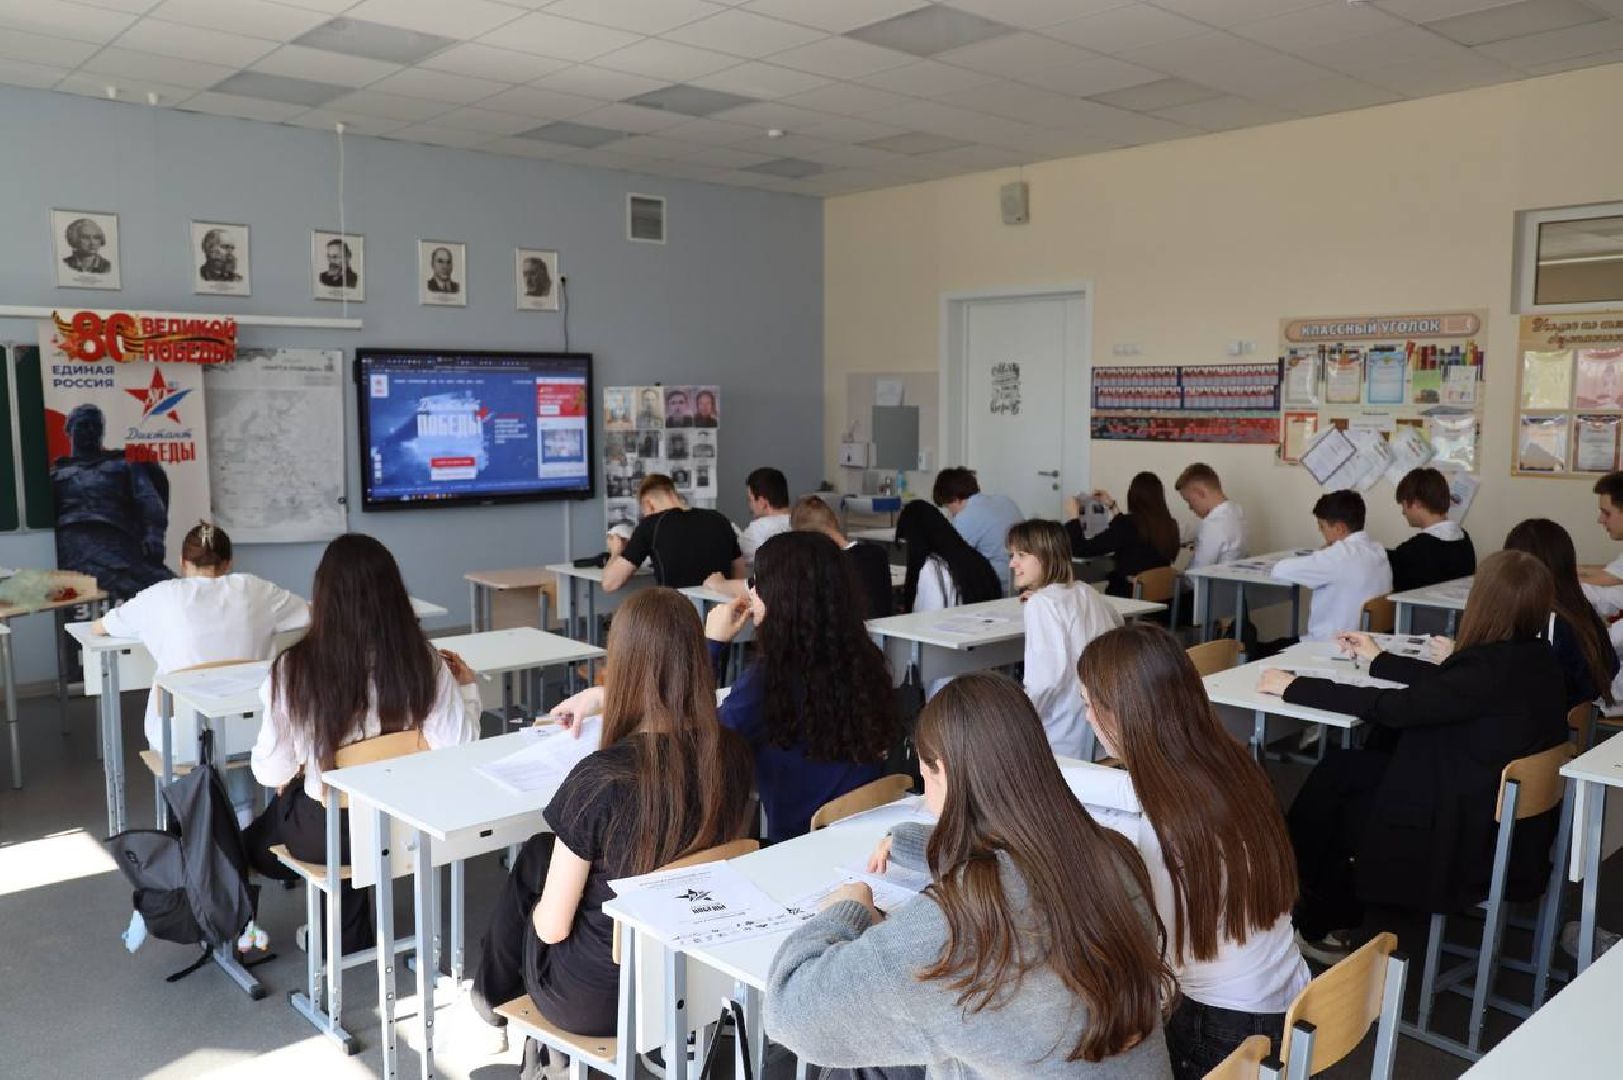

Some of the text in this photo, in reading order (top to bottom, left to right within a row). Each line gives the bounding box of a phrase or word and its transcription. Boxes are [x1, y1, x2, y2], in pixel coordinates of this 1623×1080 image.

[141, 316, 238, 338] ВЕЛИКОЙ
[1302, 318, 1440, 336] КЛАССНЫЙ УГОЛОК
[72, 310, 137, 363] 80
[52, 365, 115, 376] ЕДИНАЯ
[53, 378, 114, 388] РОССИЯ
[125, 427, 192, 440] Диктант
[125, 442, 195, 463] ПОБЕДЫ
